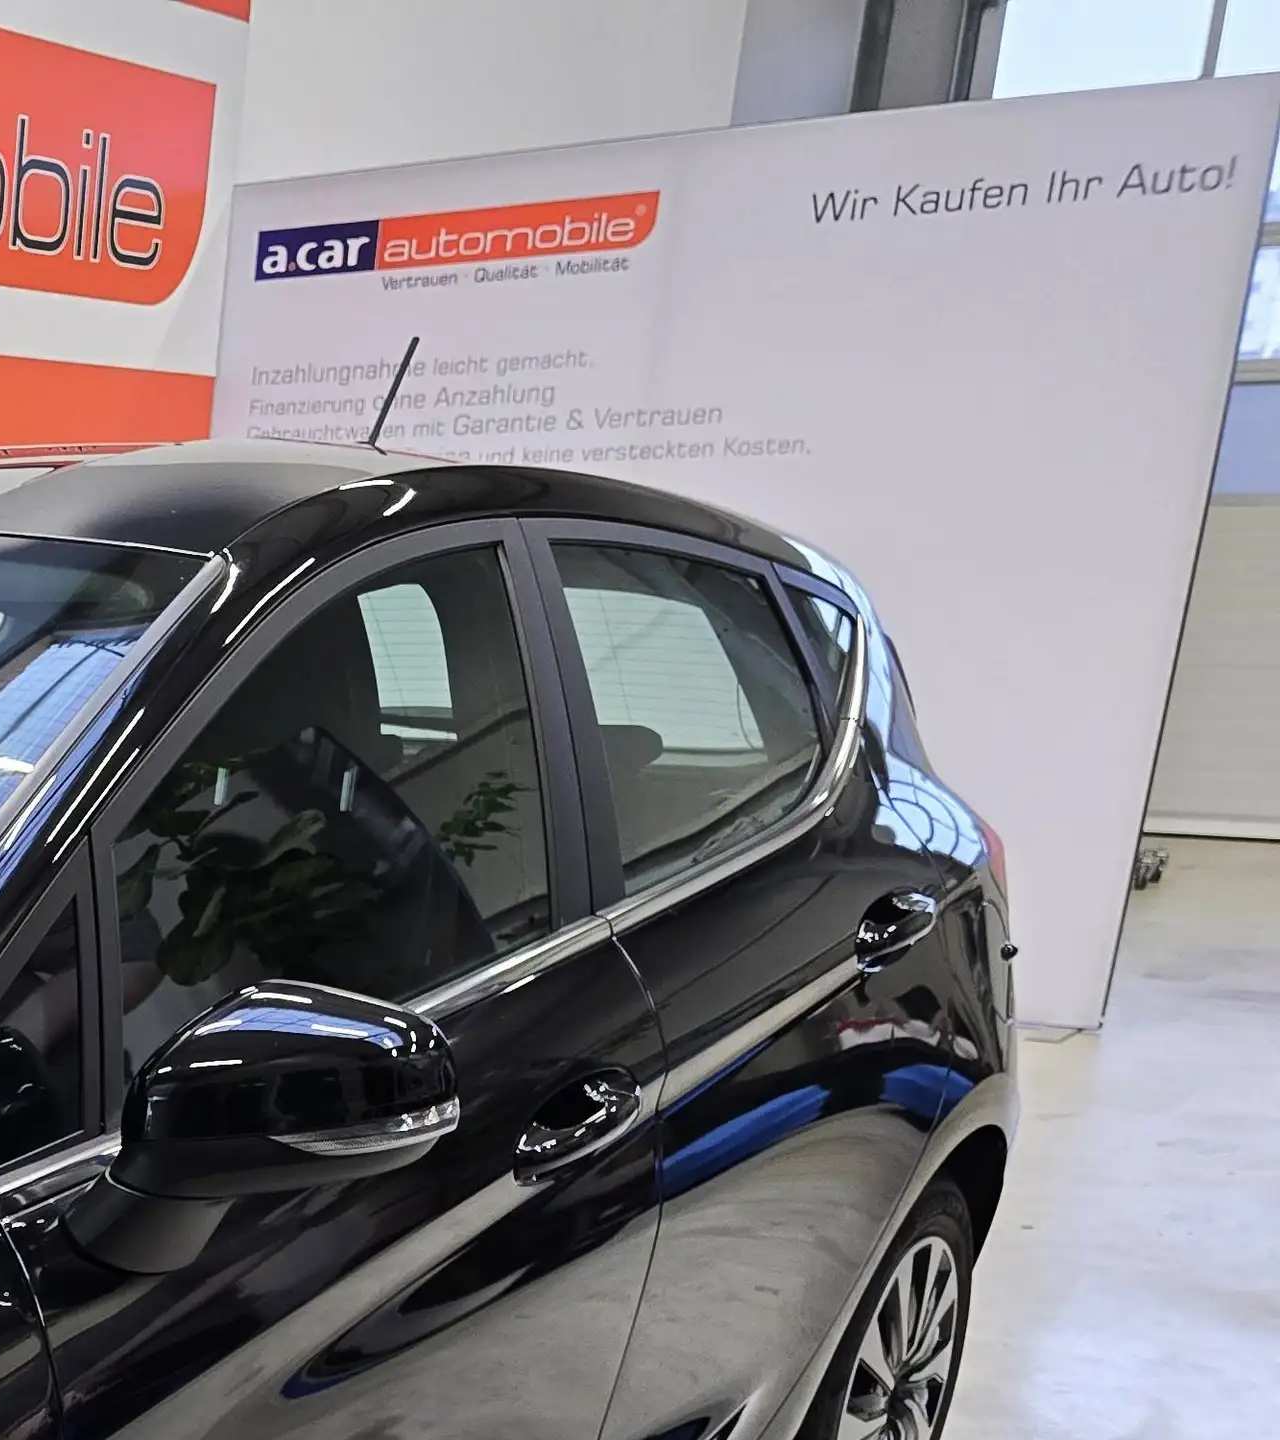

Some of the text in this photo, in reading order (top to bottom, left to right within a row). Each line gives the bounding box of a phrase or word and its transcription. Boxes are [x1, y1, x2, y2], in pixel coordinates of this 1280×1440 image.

[811, 155, 1241, 225] Wir Kaufen Ihr Auto!
[261, 235, 372, 275] a.car
[381, 272, 459, 291] Vertrauen
[251, 350, 595, 387] Inzahlungnahe leicht gemacht.
[248, 383, 556, 417] Finanzierung one Anzahlung
[247, 404, 723, 441] Gebrauchtwaen mit Garantie & Vertrauen
[522, 446, 574, 465] keine
[581, 437, 715, 462] versteckten
[722, 436, 813, 457] Kosten.
